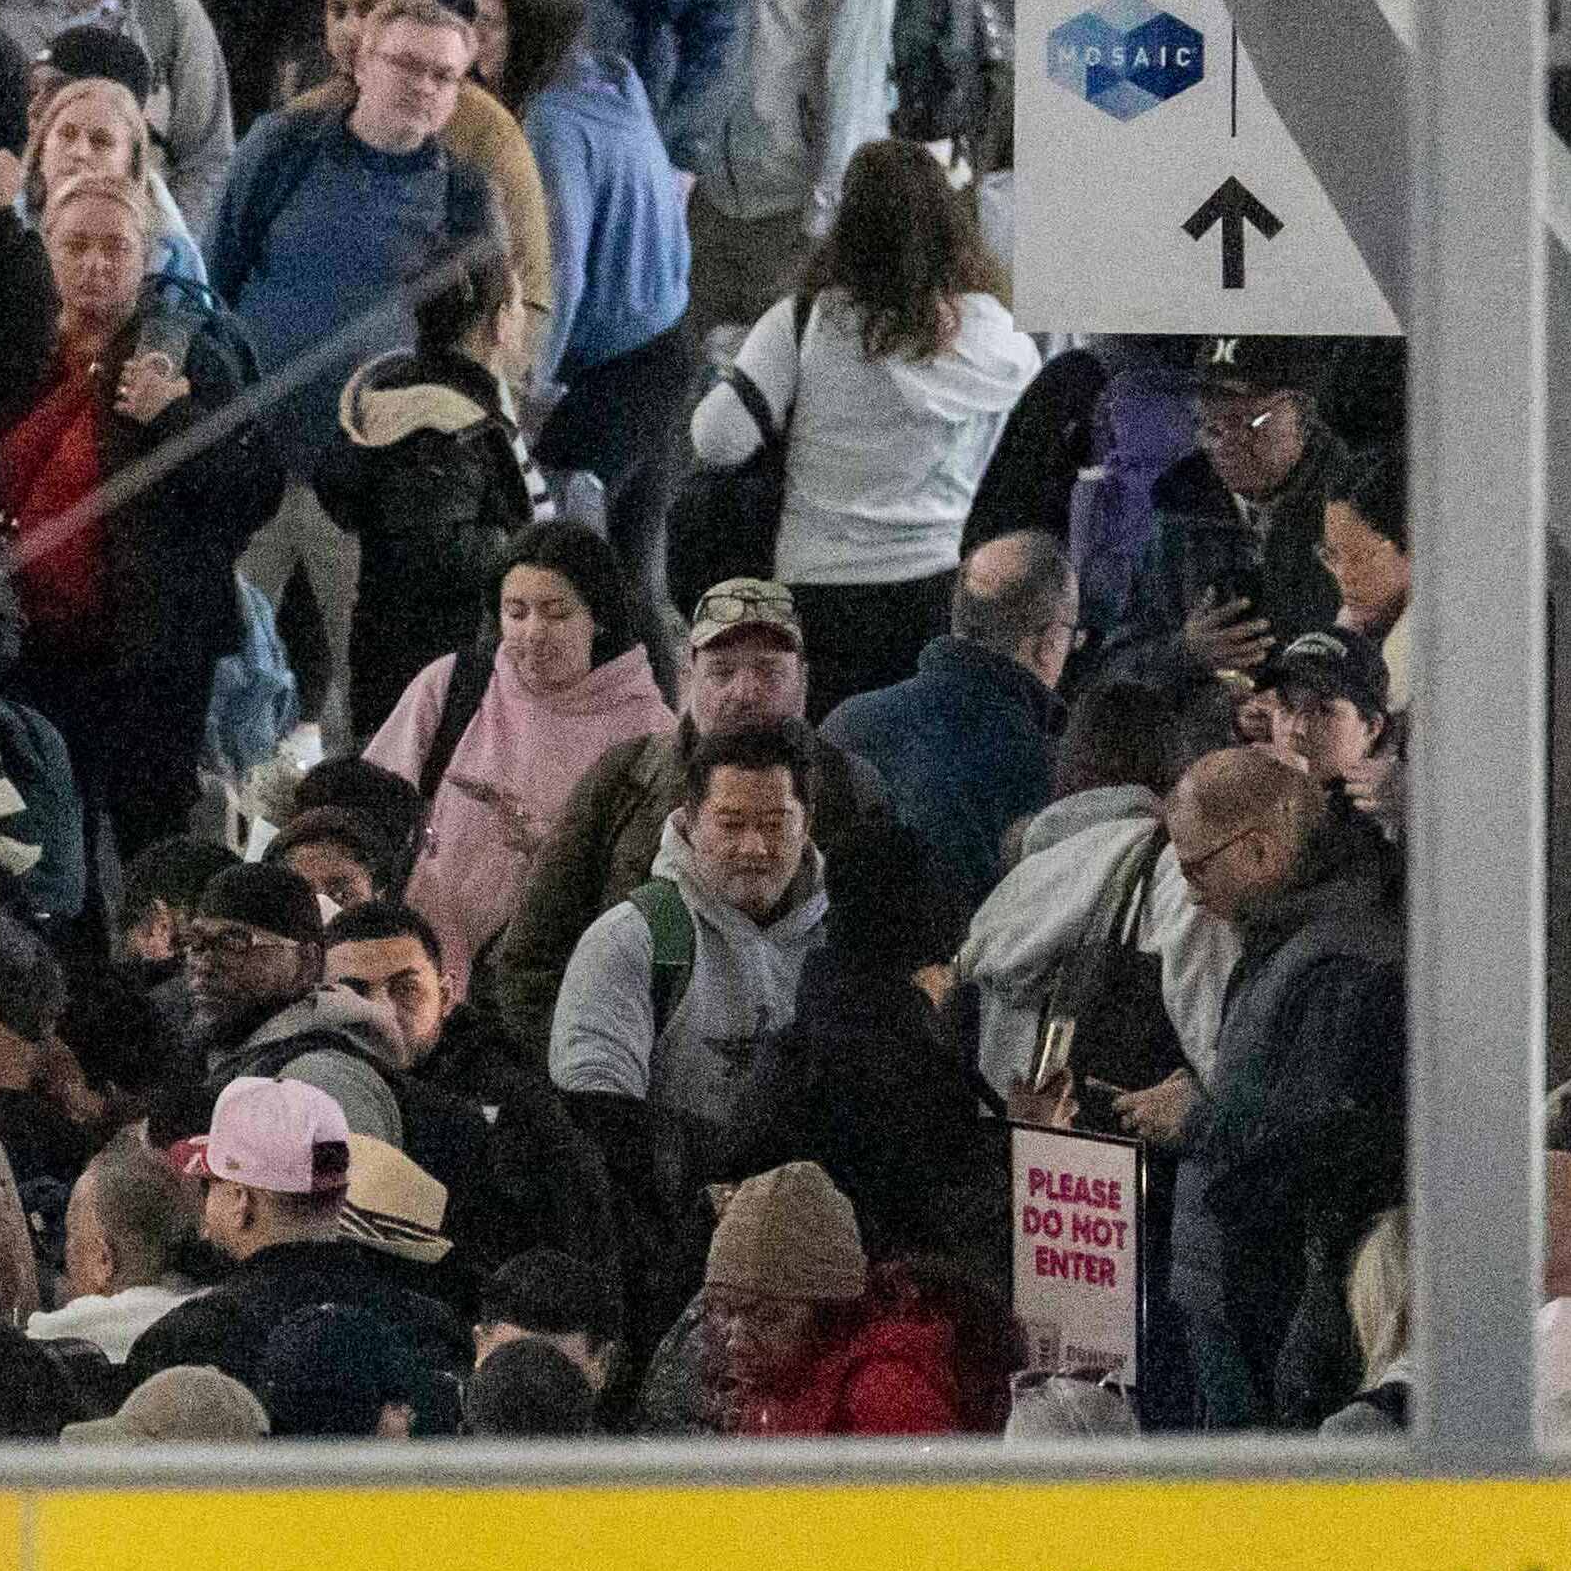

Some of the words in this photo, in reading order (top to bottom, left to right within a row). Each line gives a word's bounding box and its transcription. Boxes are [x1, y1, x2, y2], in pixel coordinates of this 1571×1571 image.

[1056, 47, 1192, 67] MOSAIC
[1027, 1167, 1122, 1210] PLEASE
[1022, 1208, 1063, 1239] DO
[1071, 1216, 1128, 1251] NOT
[1035, 1246, 1116, 1287] ENTER
